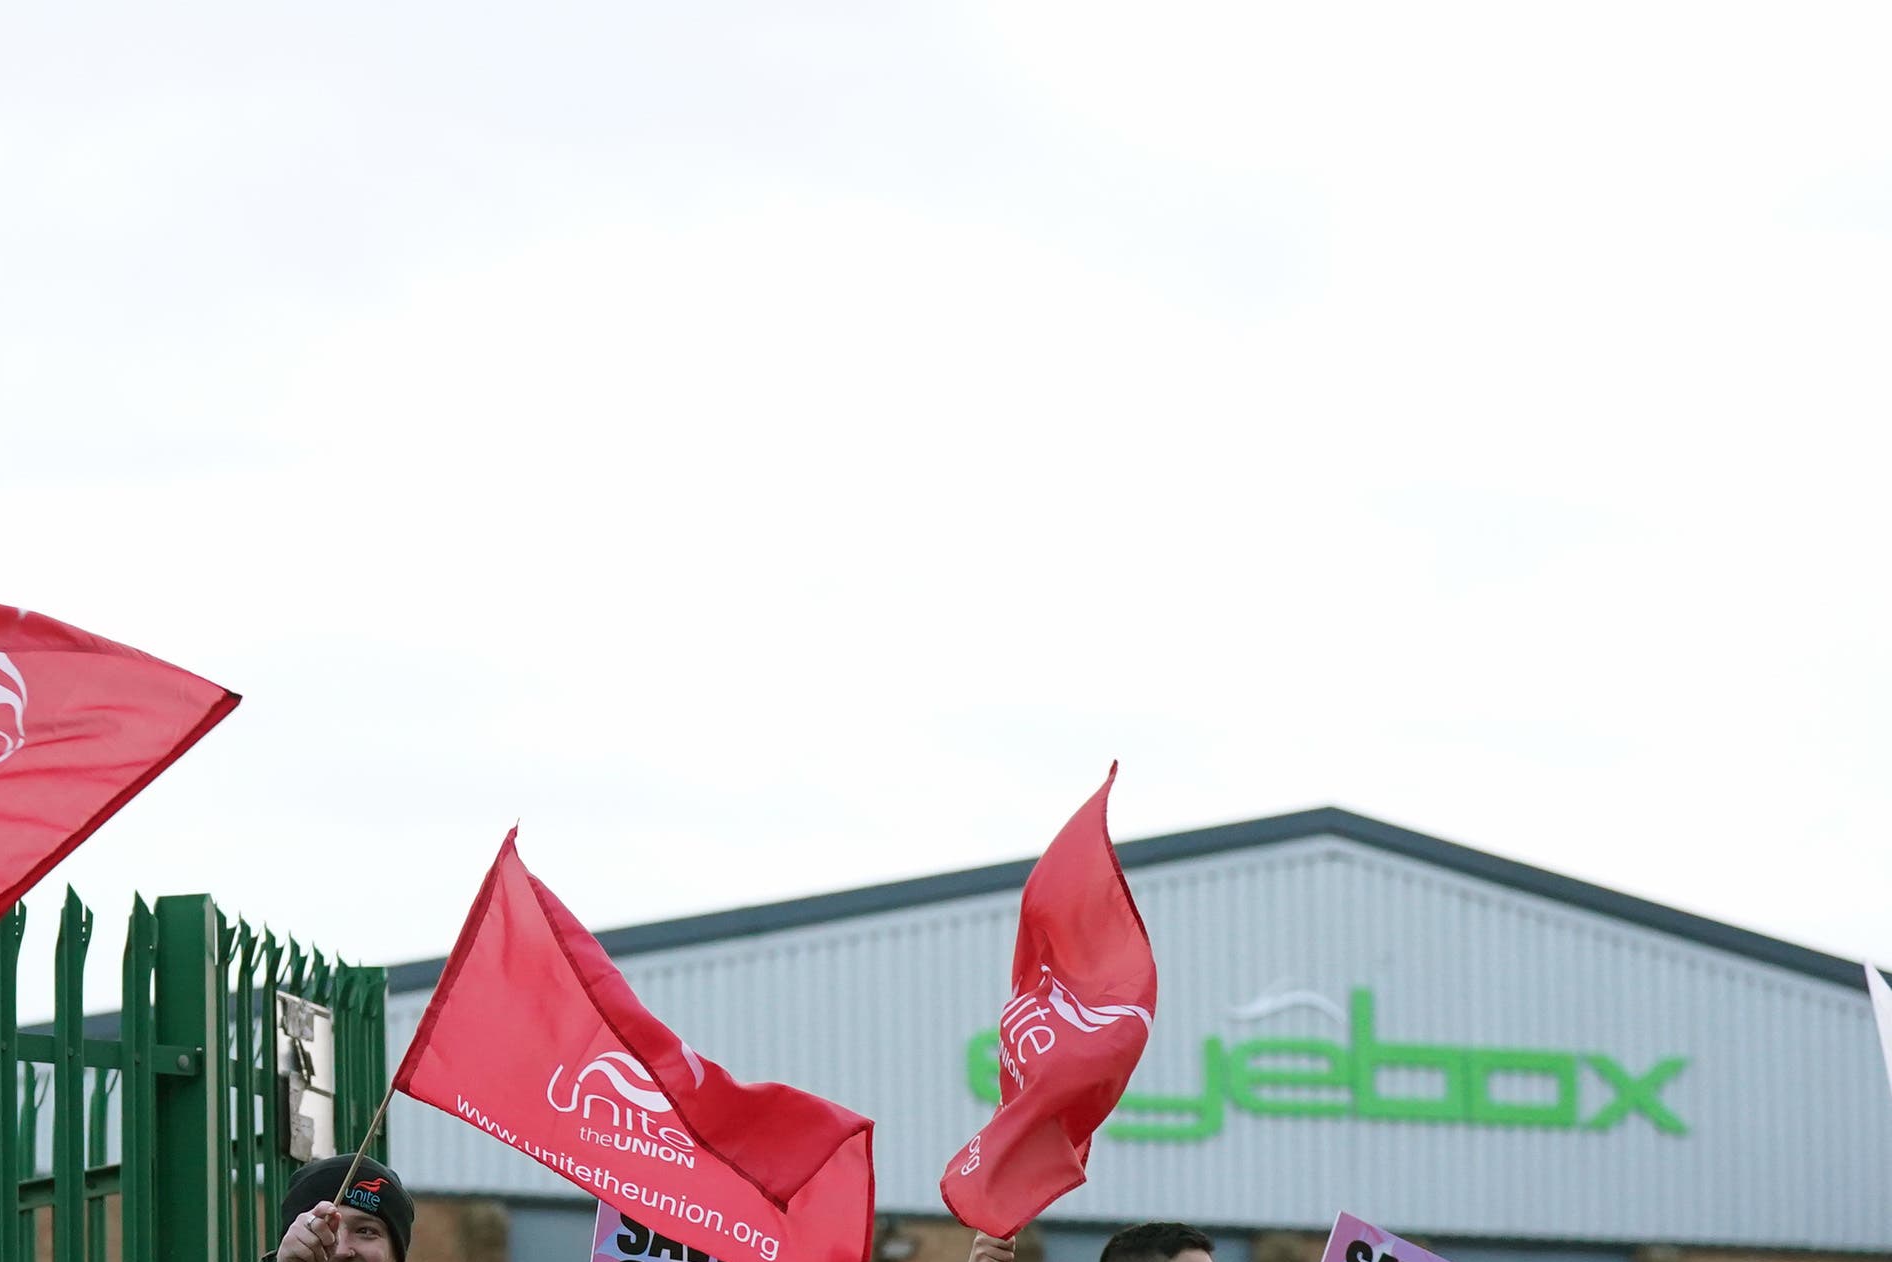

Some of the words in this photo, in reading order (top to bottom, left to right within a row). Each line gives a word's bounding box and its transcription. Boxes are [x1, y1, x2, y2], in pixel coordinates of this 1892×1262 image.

[547, 1064, 695, 1151] unite
[344, 1188, 381, 1207] unite
[456, 1095, 781, 1262] www.unitetheunion.org
